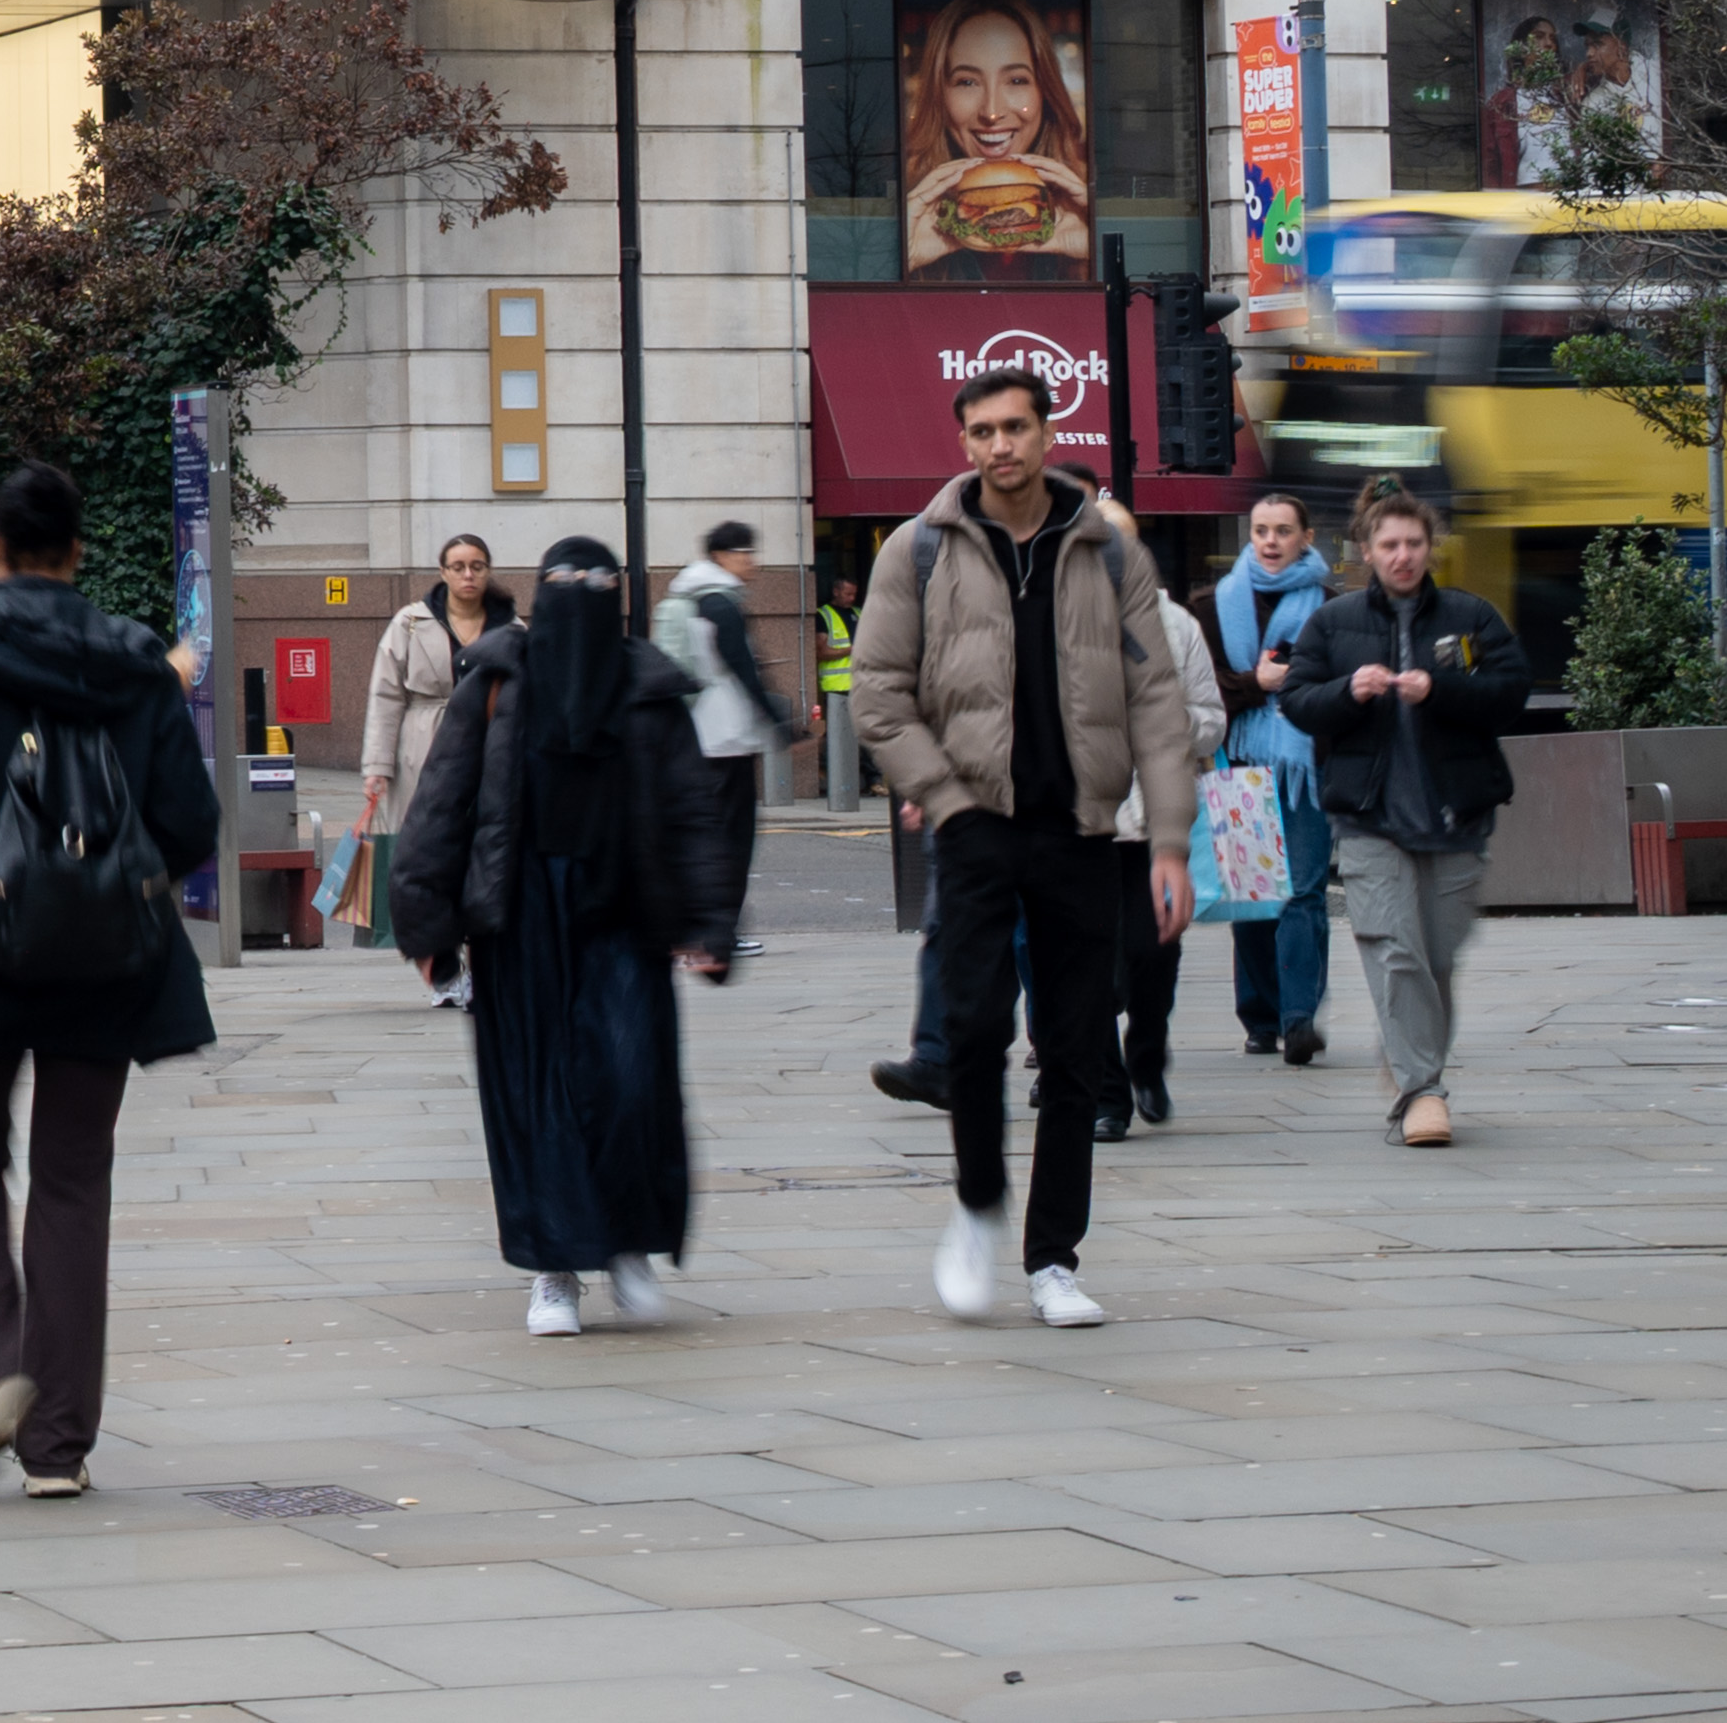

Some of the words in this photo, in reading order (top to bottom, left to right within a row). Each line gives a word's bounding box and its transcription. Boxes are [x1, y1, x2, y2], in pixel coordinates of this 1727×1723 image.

[1243, 65, 1294, 92] SUPER
[1243, 87, 1294, 114] DUPER
[1028, 350, 1109, 387] Rock
[329, 579, 345, 602] H
